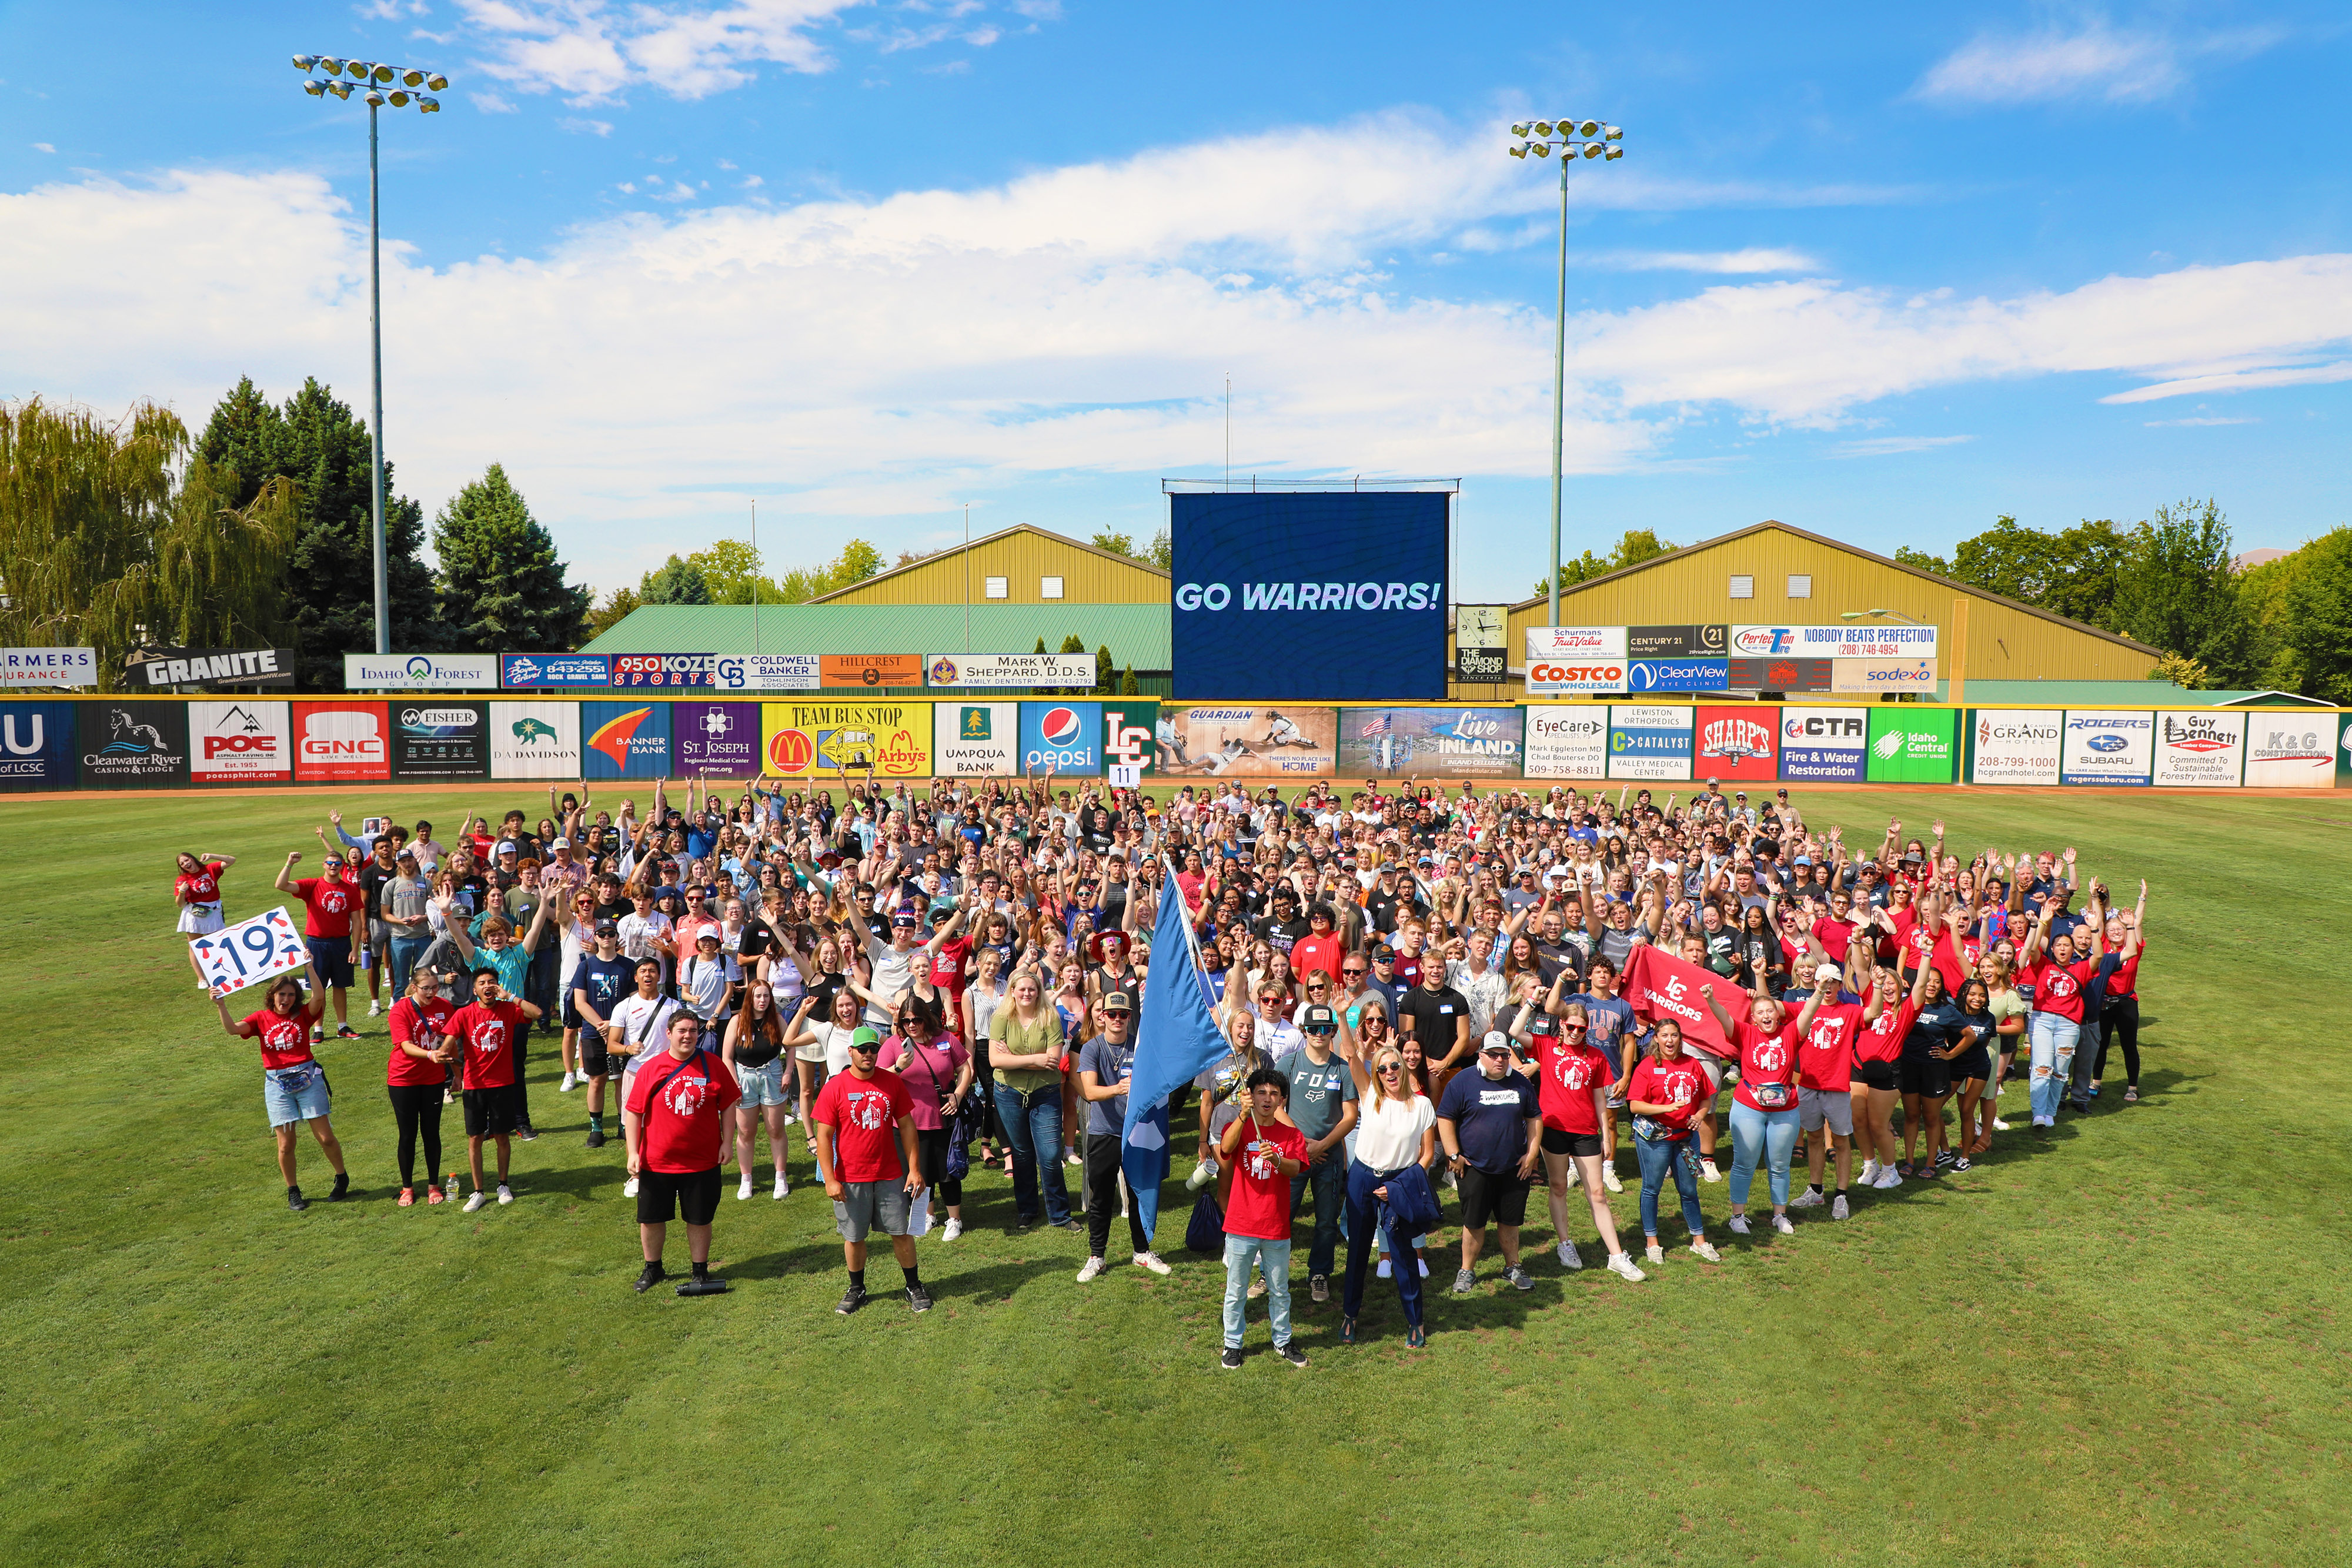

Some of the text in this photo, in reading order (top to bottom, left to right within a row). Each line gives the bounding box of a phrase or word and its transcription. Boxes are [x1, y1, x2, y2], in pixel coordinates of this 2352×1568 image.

[1176, 583, 1441, 611] GO WARRIORS!
[1805, 629, 1934, 642] NOBODY BEATS PERFECTION
[1461, 649, 1480, 657] THE
[1839, 644, 1898, 656] (208) 746-4954
[620, 656, 715, 672] 950 KOZE
[751, 657, 818, 665] COLDWELL
[840, 657, 901, 666] HILLCREST
[998, 657, 1058, 666] MARK W.
[1461, 657, 1503, 666] DIAMOND
[146, 650, 278, 685] GRANITE
[361, 667, 482, 679] IDAHO FOREST
[760, 667, 808, 675] BANKER
[967, 667, 1090, 677] SHEPPARD, D.D.S.
[1477, 665, 1502, 673] SHOP
[1531, 664, 1622, 681] COSTCO
[1659, 666, 1726, 678] ClearView
[218, 671, 291, 684] GraniteConceptsNW.com
[614, 673, 716, 686] SPORTS
[1866, 667, 1930, 681] sodexo
[425, 713, 473, 722] FISHER
[792, 707, 903, 727] TEAM BUS STOP
[1190, 710, 1254, 719] GUARDIAN
[1452, 711, 1500, 740] Live
[1537, 720, 1589, 737] EyeCare
[1806, 718, 1863, 736] CTR
[2067, 718, 2152, 729] ROGERS
[2188, 716, 2216, 730] Guy
[1704, 719, 1769, 753] SHARP'S
[1994, 723, 2057, 738] GRAND
[2166, 728, 2237, 744] Bennett
[1105, 712, 1151, 769] LC
[1638, 737, 1689, 748] CATALYST
[1908, 733, 1937, 742] Idaho
[2267, 732, 2317, 749] K & G
[204, 735, 276, 760] POE
[305, 740, 380, 753] GNC
[706, 741, 749, 757] JOSEPH
[1439, 739, 1515, 755] INLAND
[1551, 745, 1586, 754] Eggleston
[1907, 743, 1947, 752] Central
[84, 753, 183, 765] Clearwater River
[877, 747, 926, 764] Arby's
[946, 749, 1005, 759] UMPQUA
[1027, 747, 1092, 770] pepsi
[1786, 752, 1859, 763] Fire & Water
[2169, 755, 2216, 764] Committed
[957, 763, 995, 772] BANK
[1979, 757, 2056, 767] 208-799-1000
[15, 764, 44, 773] LCSC
[132, 765, 141, 774] &
[1529, 765, 1601, 774] 509-758-8811
[1788, 765, 1855, 776] Restoration
[1978, 768, 2055, 777] hcgrandhotel.com
[206, 772, 276, 780] poeasphalt.com
[1117, 767, 1130, 783] 11
[2160, 772, 2197, 781] Forestry
[219, 925, 274, 976] 19
[1665, 975, 1688, 1001] LC
[1643, 987, 1703, 1022] WARRIORS
[1492, 1033, 1501, 1041] LC
